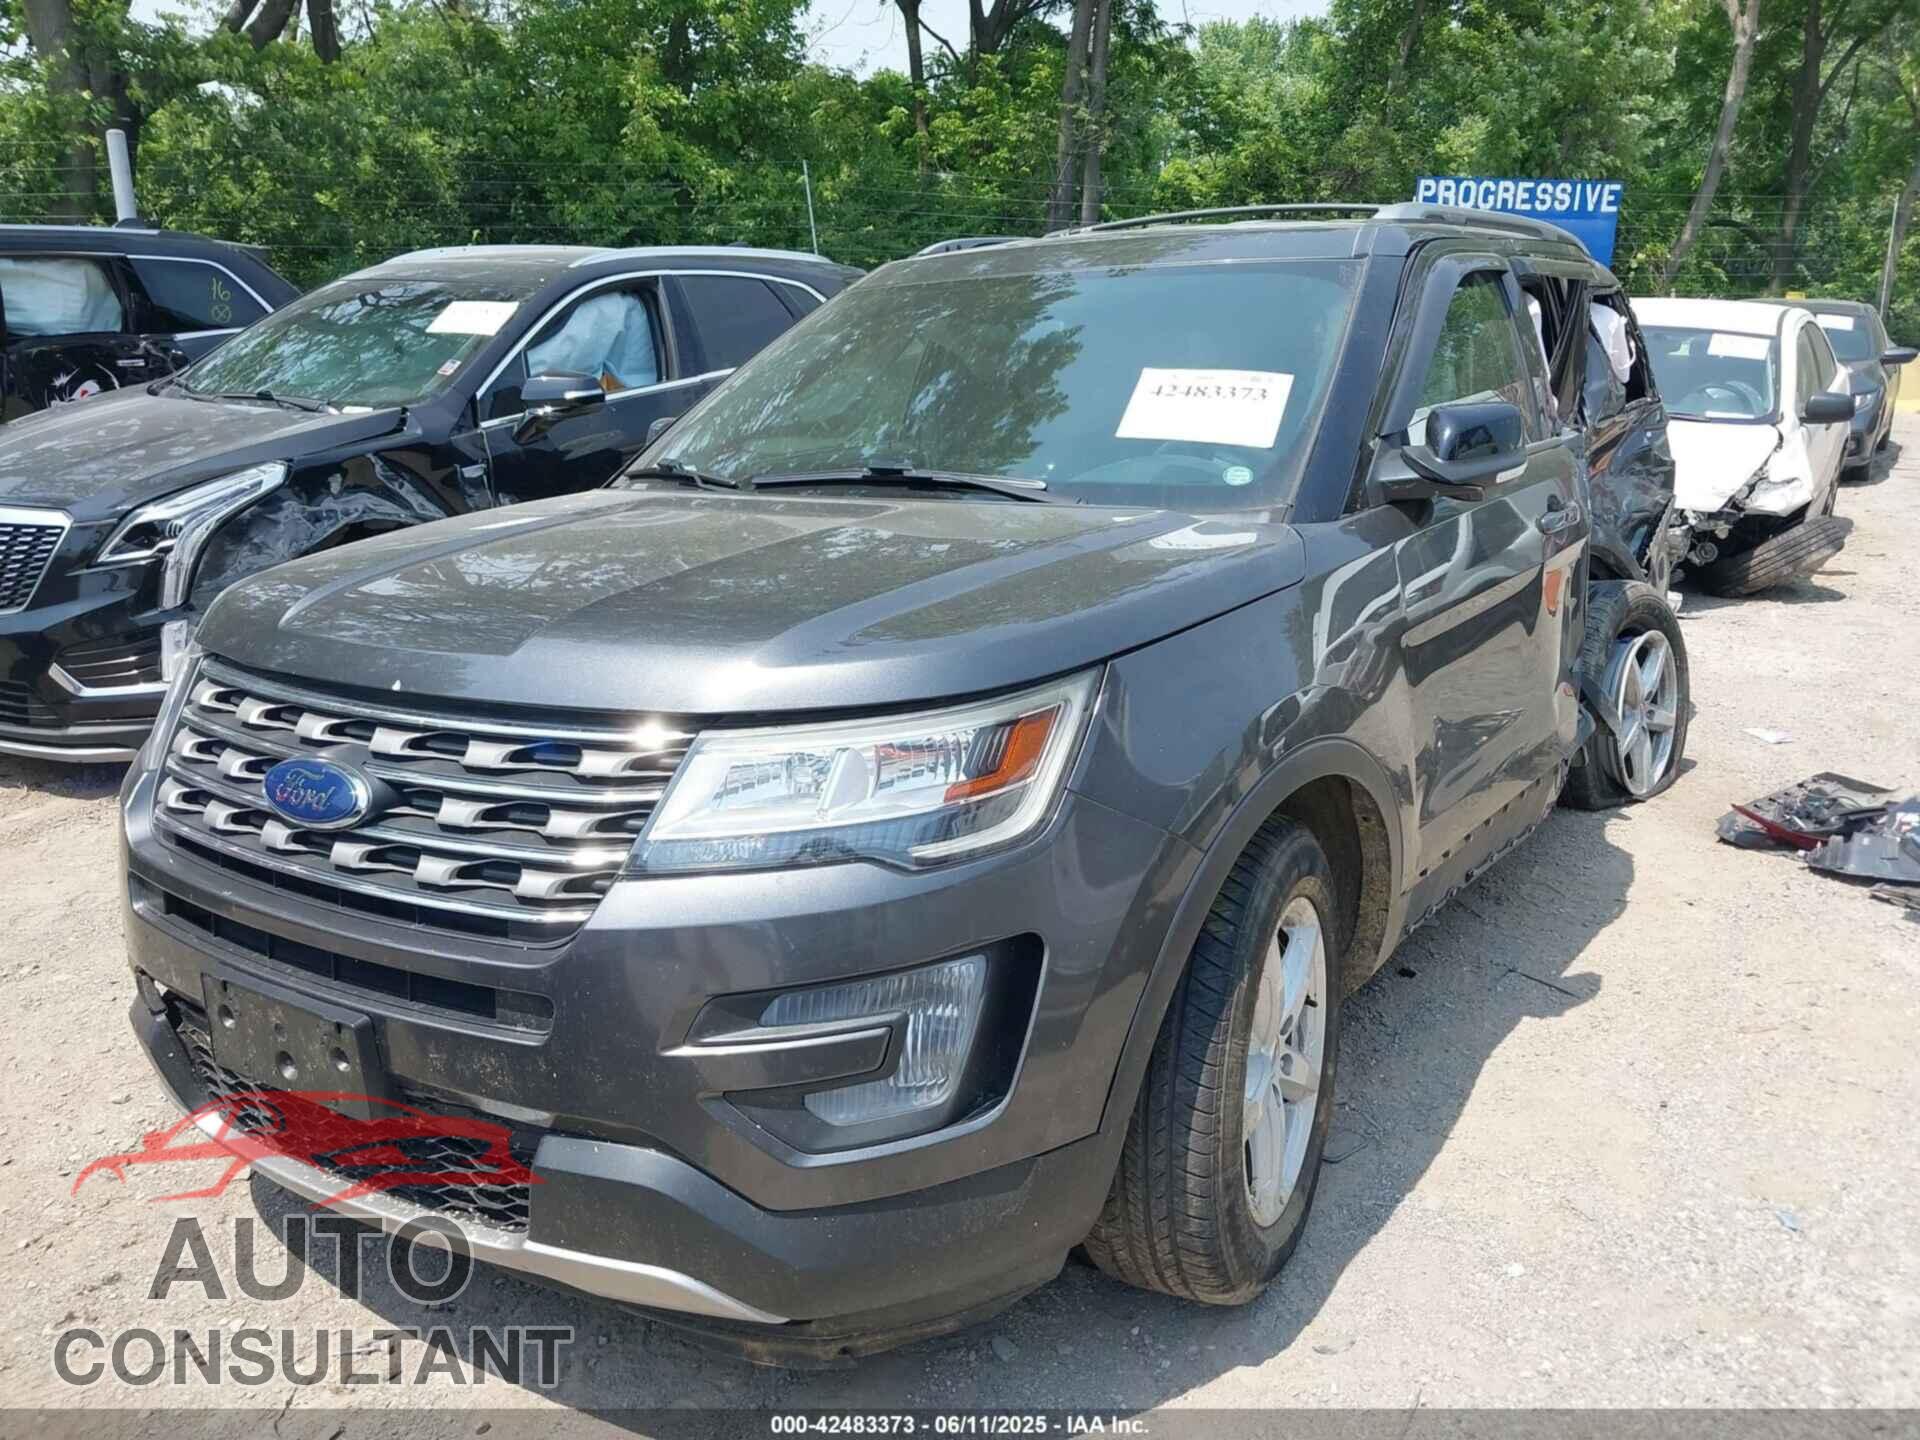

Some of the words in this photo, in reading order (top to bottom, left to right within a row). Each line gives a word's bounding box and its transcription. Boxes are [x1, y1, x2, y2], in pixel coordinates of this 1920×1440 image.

[1417, 178, 1622, 213] PROGRESSIVE
[1151, 384, 1269, 401] 42483373
[275, 767, 337, 812] Ford
